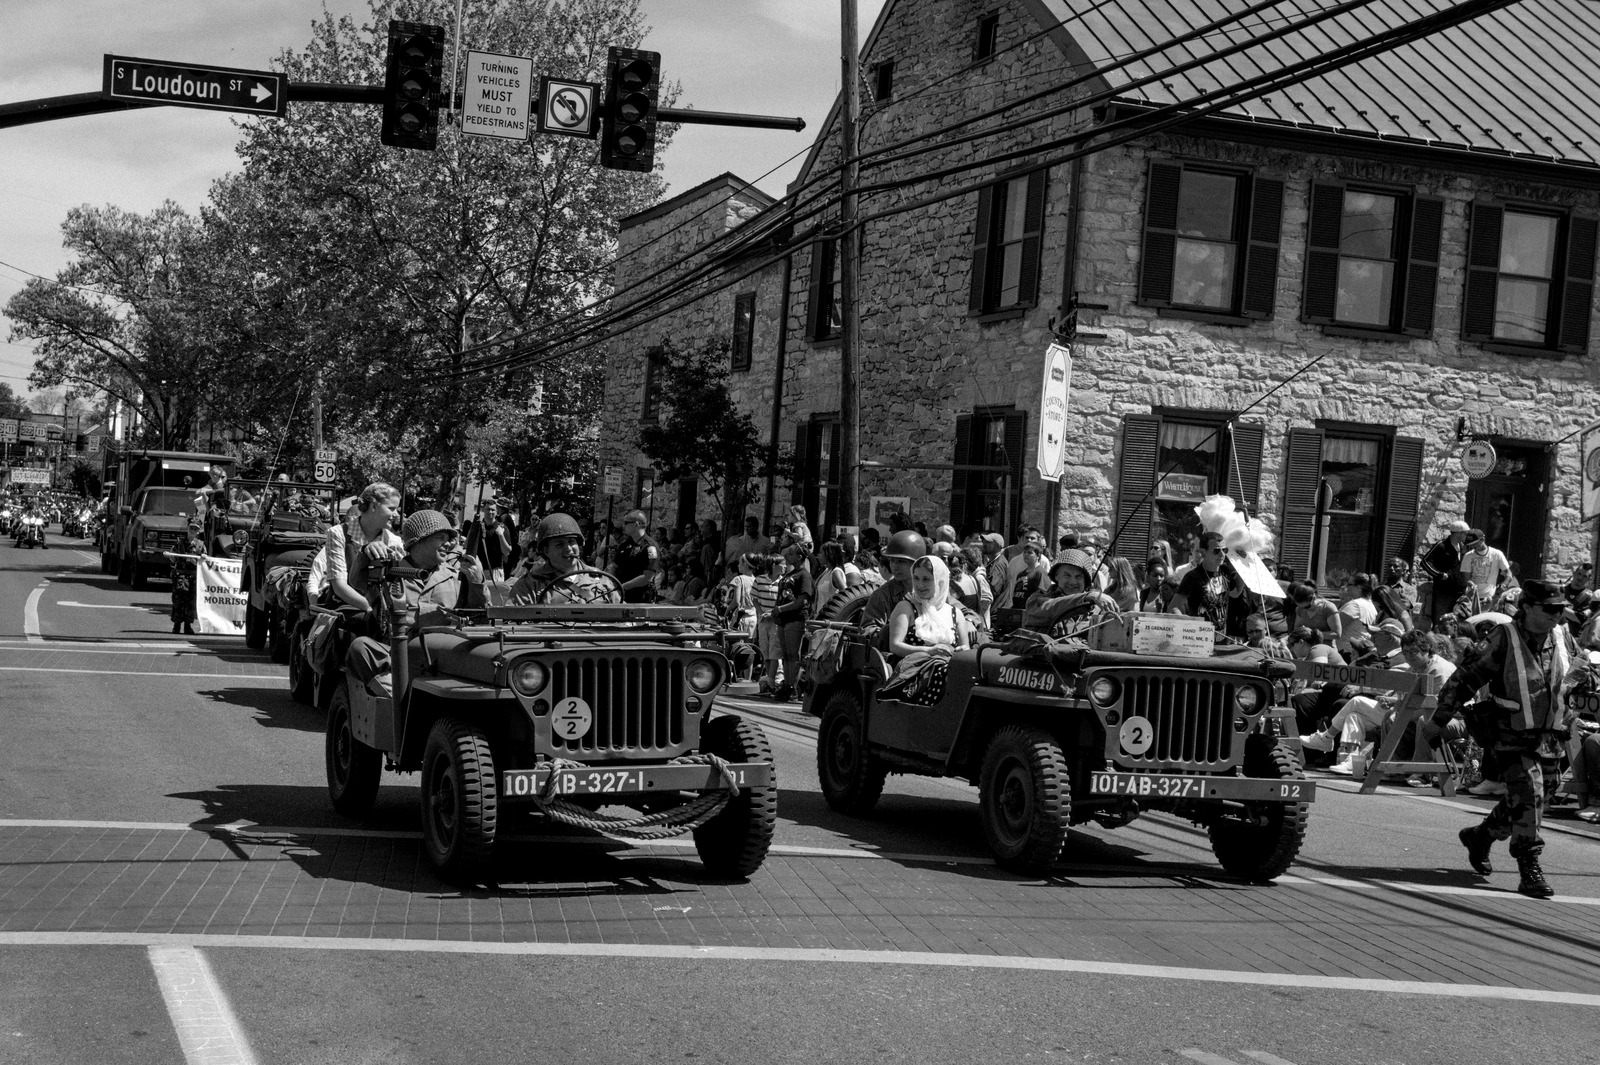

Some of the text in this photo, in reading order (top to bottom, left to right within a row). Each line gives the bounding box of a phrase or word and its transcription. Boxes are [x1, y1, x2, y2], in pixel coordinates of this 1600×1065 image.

[481, 62, 518, 75] TURNING
[117, 67, 243, 99] S Loudoun ST
[477, 75, 520, 88] VEHICLES
[481, 89, 513, 102] MUST
[477, 104, 516, 116] YIELD TO
[466, 115, 524, 130] PEDESTRIANS
[1046, 396, 1065, 412] COUNTRY
[1047, 409, 1062, 422] STORE
[319, 451, 333, 459] EAST
[316, 465, 334, 478] 50
[204, 585, 231, 594] JOHN
[998, 666, 1055, 691] 20101549
[1313, 664, 1367, 685] DETOUR
[567, 700, 577, 714] 2
[566, 721, 577, 735] 2
[1132, 727, 1143, 744] 2
